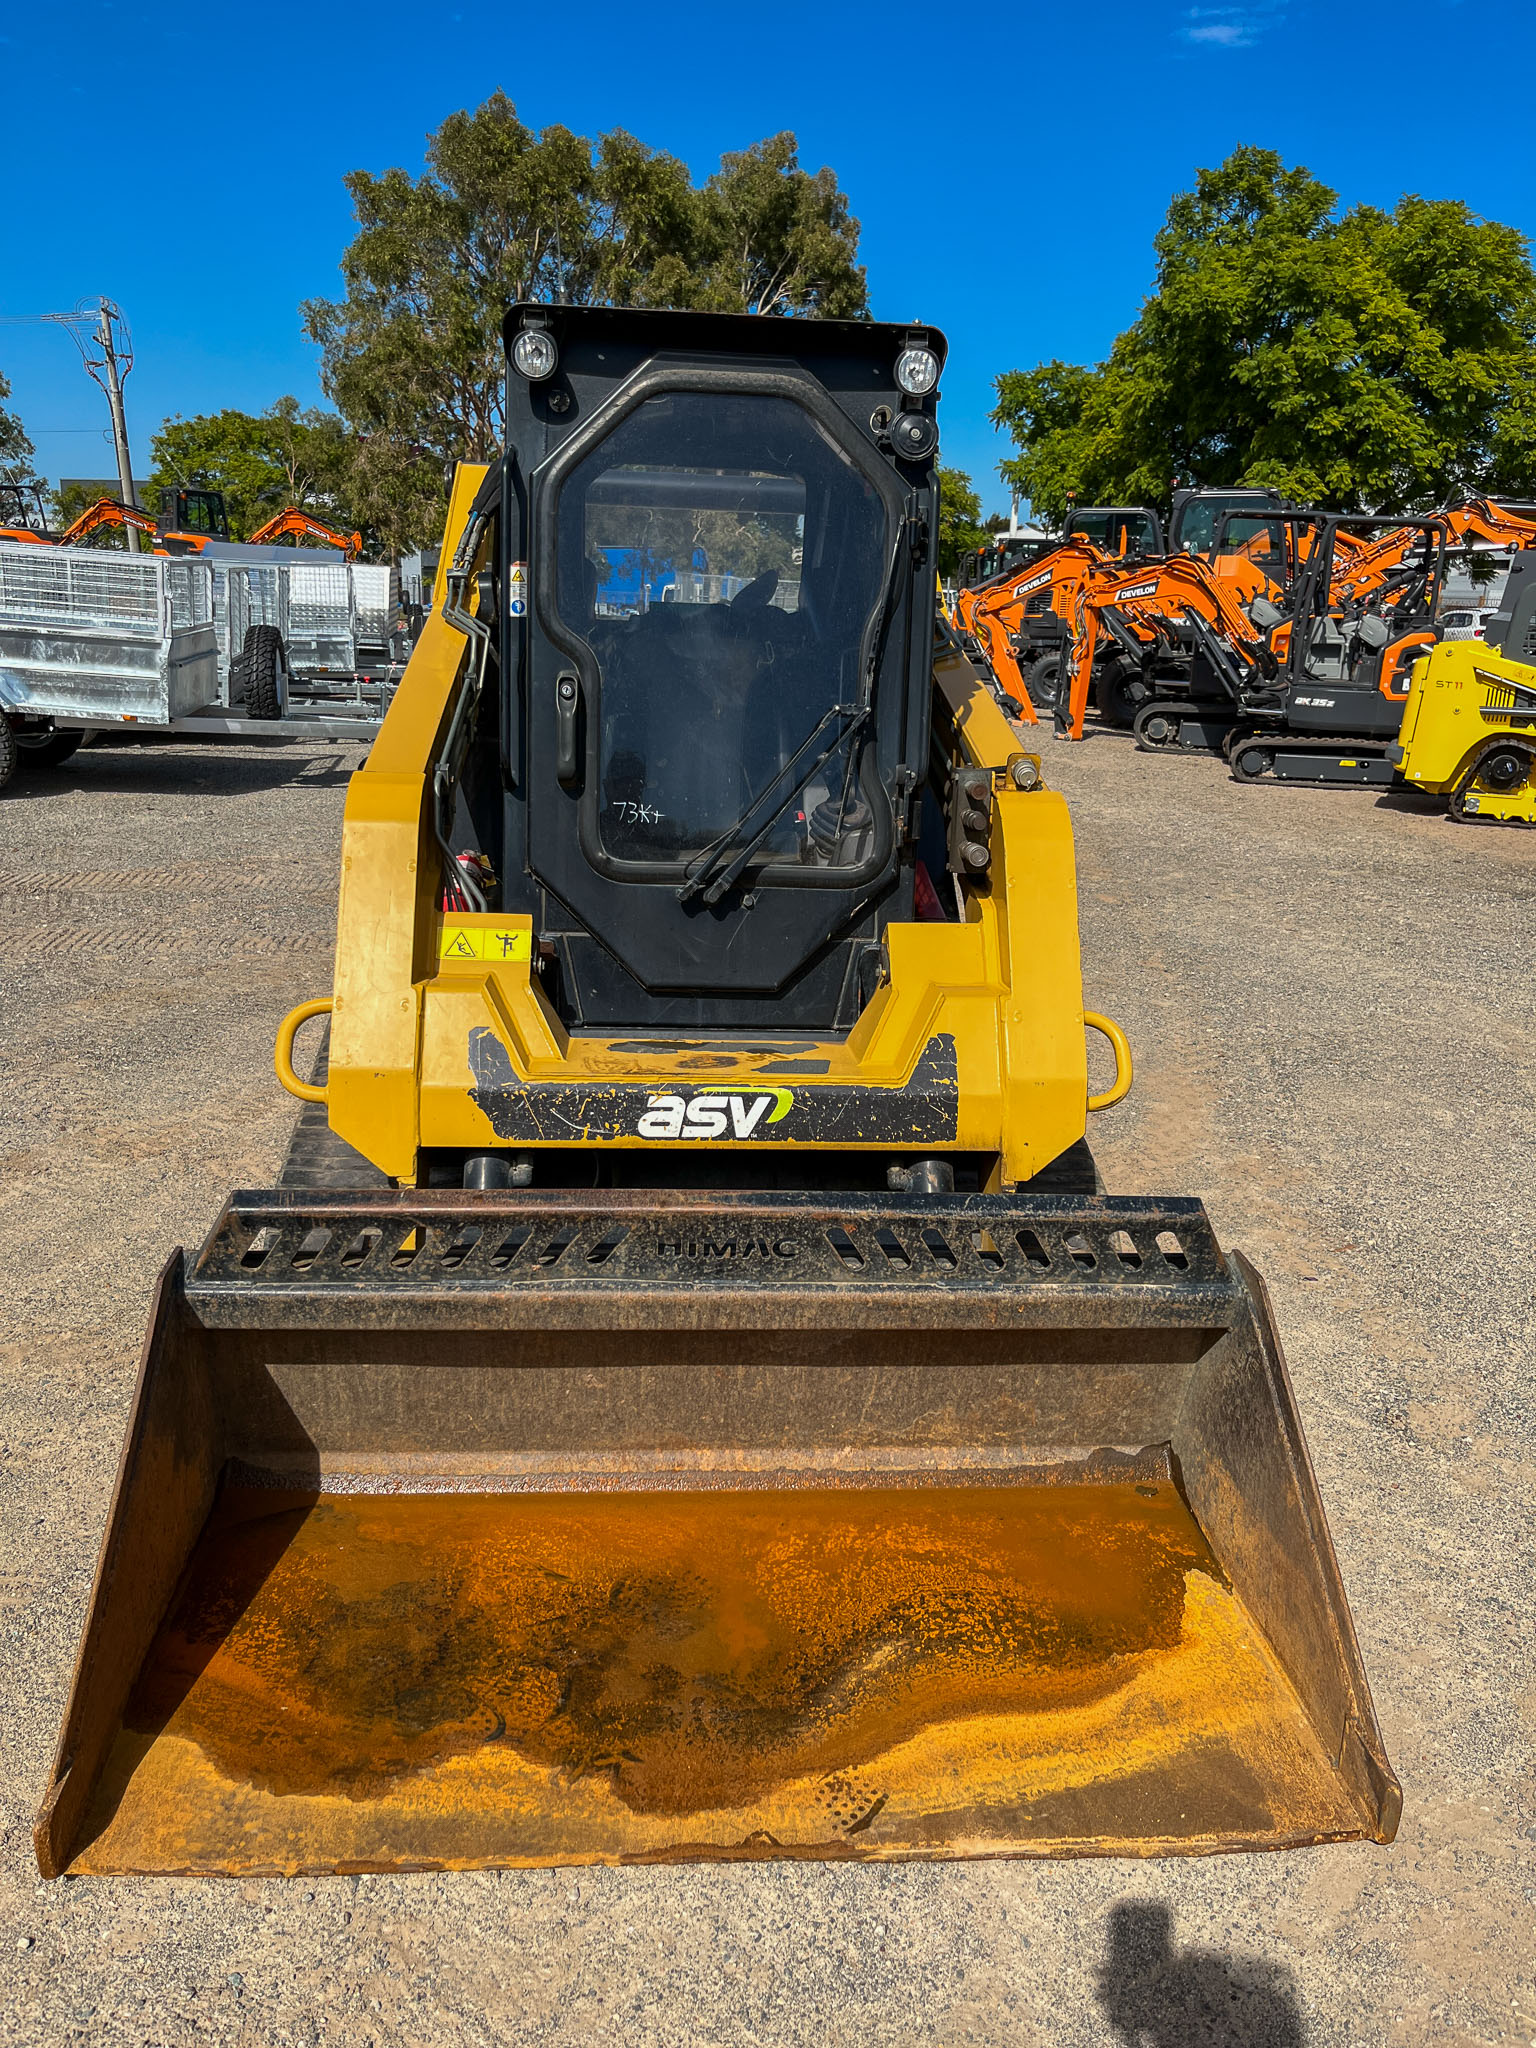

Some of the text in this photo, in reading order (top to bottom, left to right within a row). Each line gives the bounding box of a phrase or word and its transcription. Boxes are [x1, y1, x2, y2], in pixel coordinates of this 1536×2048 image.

[1018, 572, 1052, 594] DEVELON
[1120, 585, 1156, 599] DEVELON
[657, 1237, 800, 1260] HIMAC
